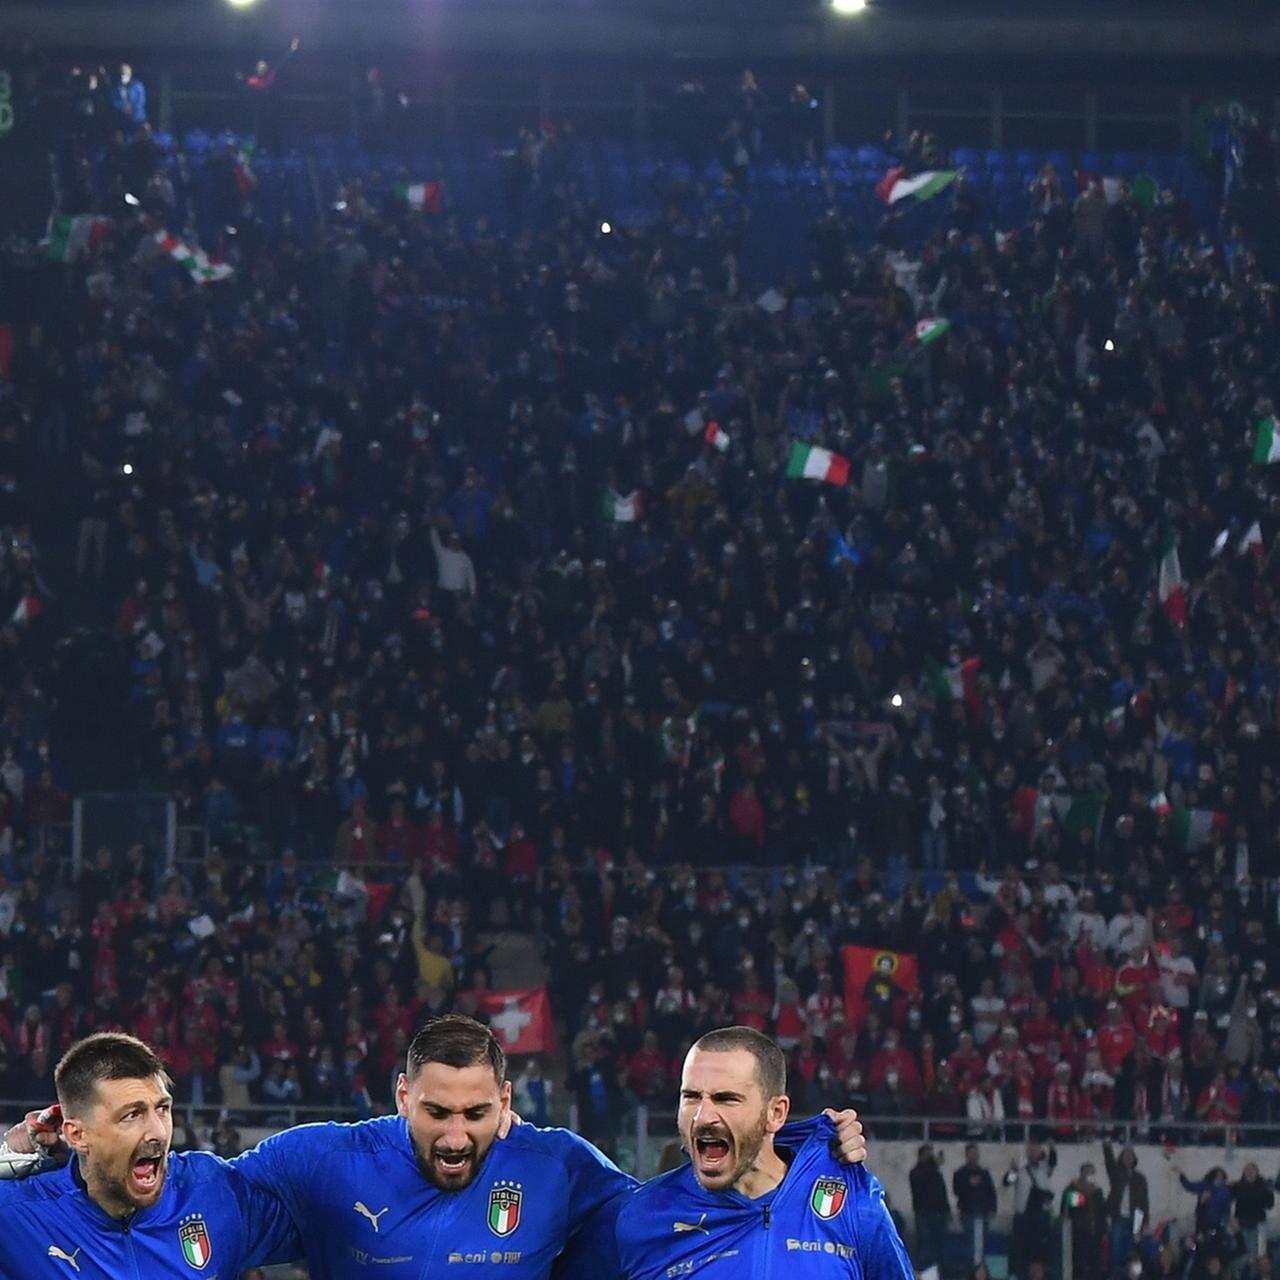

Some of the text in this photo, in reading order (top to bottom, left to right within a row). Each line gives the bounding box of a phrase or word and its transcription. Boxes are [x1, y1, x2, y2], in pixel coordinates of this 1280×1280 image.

[492, 1191, 519, 1202] ITALIA
[180, 1224, 204, 1238] ITALIA
[801, 1238, 822, 1252] eni
[465, 1250, 486, 1263] eni
